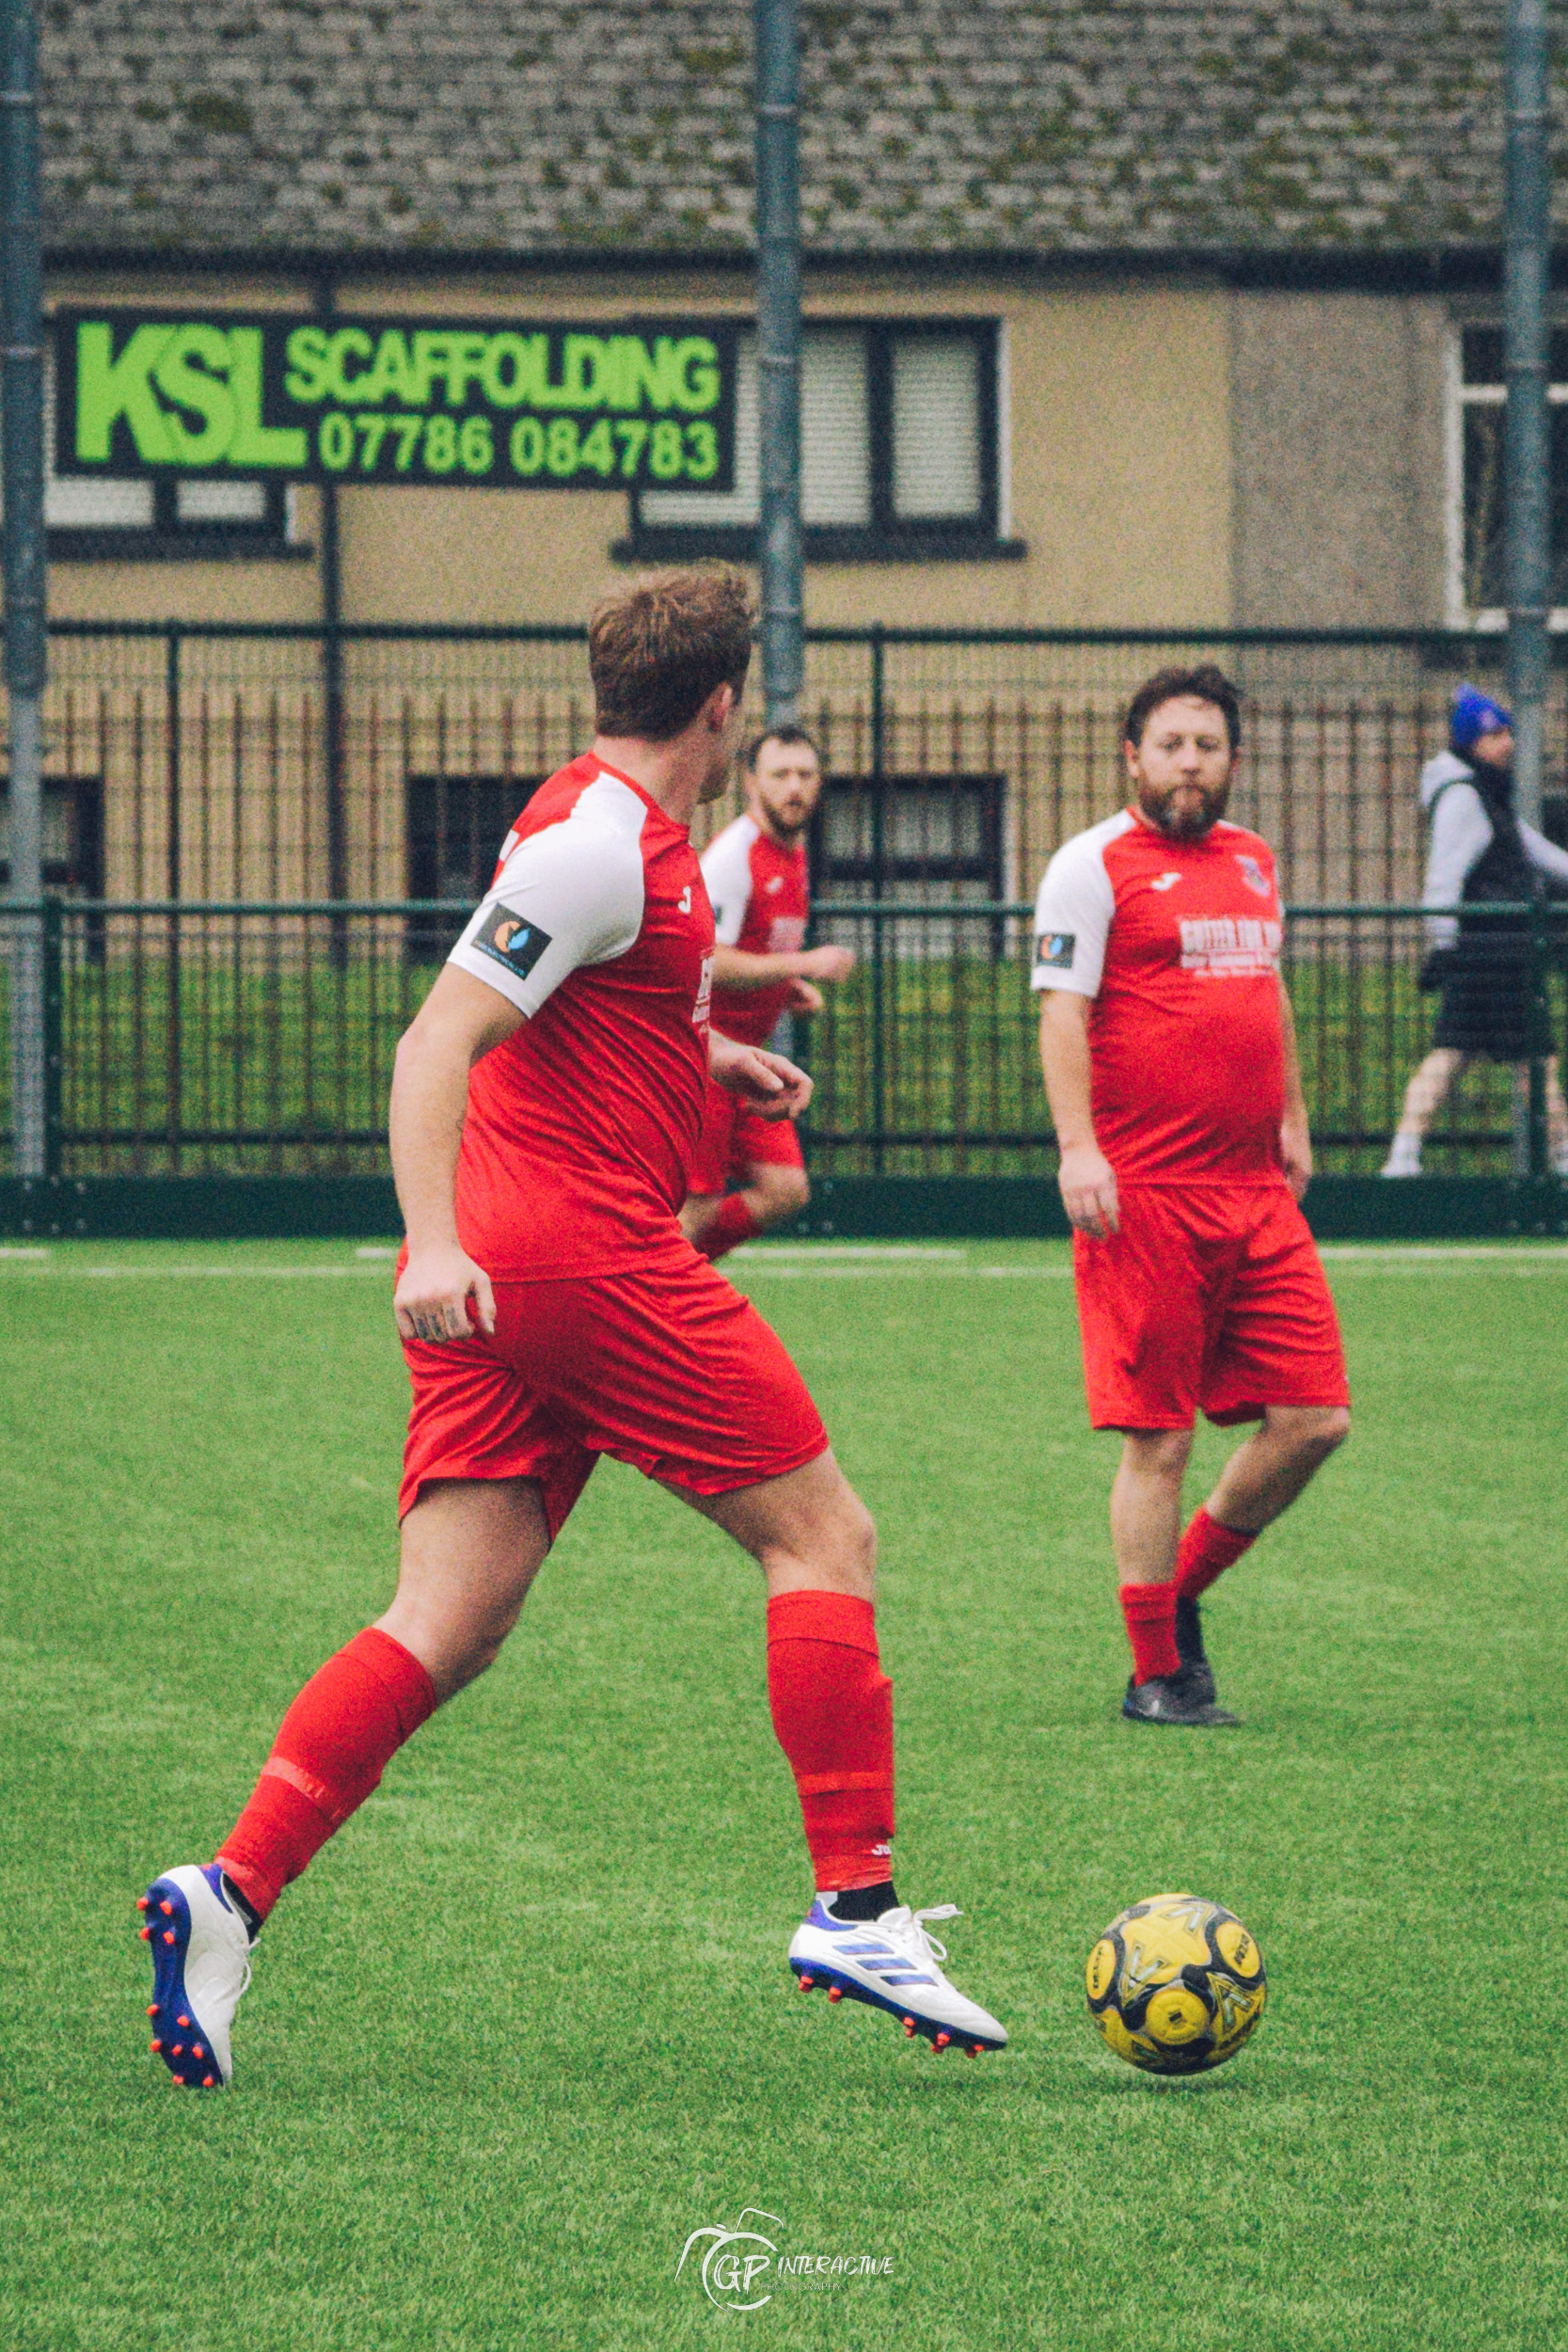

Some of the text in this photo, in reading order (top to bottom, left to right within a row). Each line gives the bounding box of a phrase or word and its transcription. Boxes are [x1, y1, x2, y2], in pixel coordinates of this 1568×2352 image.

[75, 322, 309, 468] KSL
[284, 326, 721, 413] SCAFFOLDING
[318, 411, 721, 480] 07786 084783
